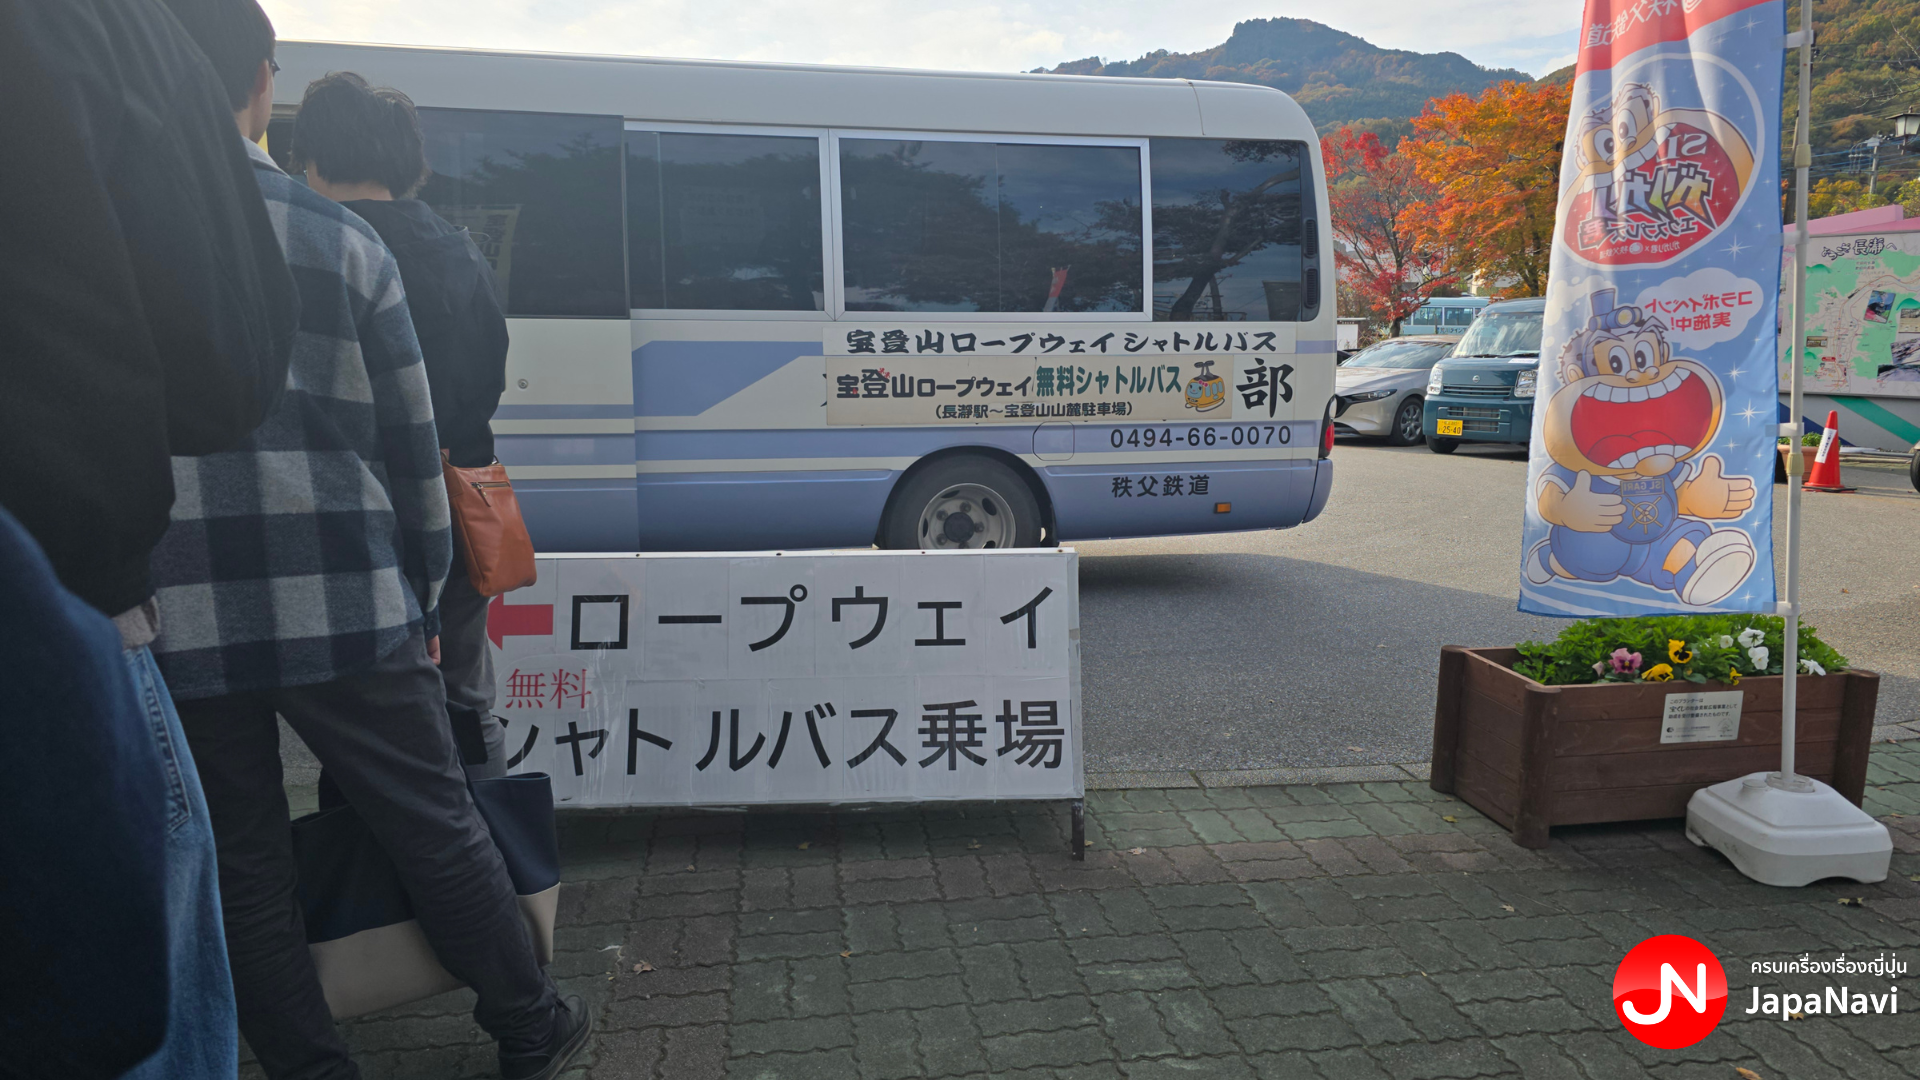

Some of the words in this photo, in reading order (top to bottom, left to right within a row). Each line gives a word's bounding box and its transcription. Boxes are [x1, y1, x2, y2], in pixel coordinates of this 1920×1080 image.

[1236, 357, 1295, 418] 部
[1110, 425, 1292, 448] 0494-66-0070
[1111, 474, 1210, 498] 秩父鉄道
[505, 668, 592, 709] 無料
